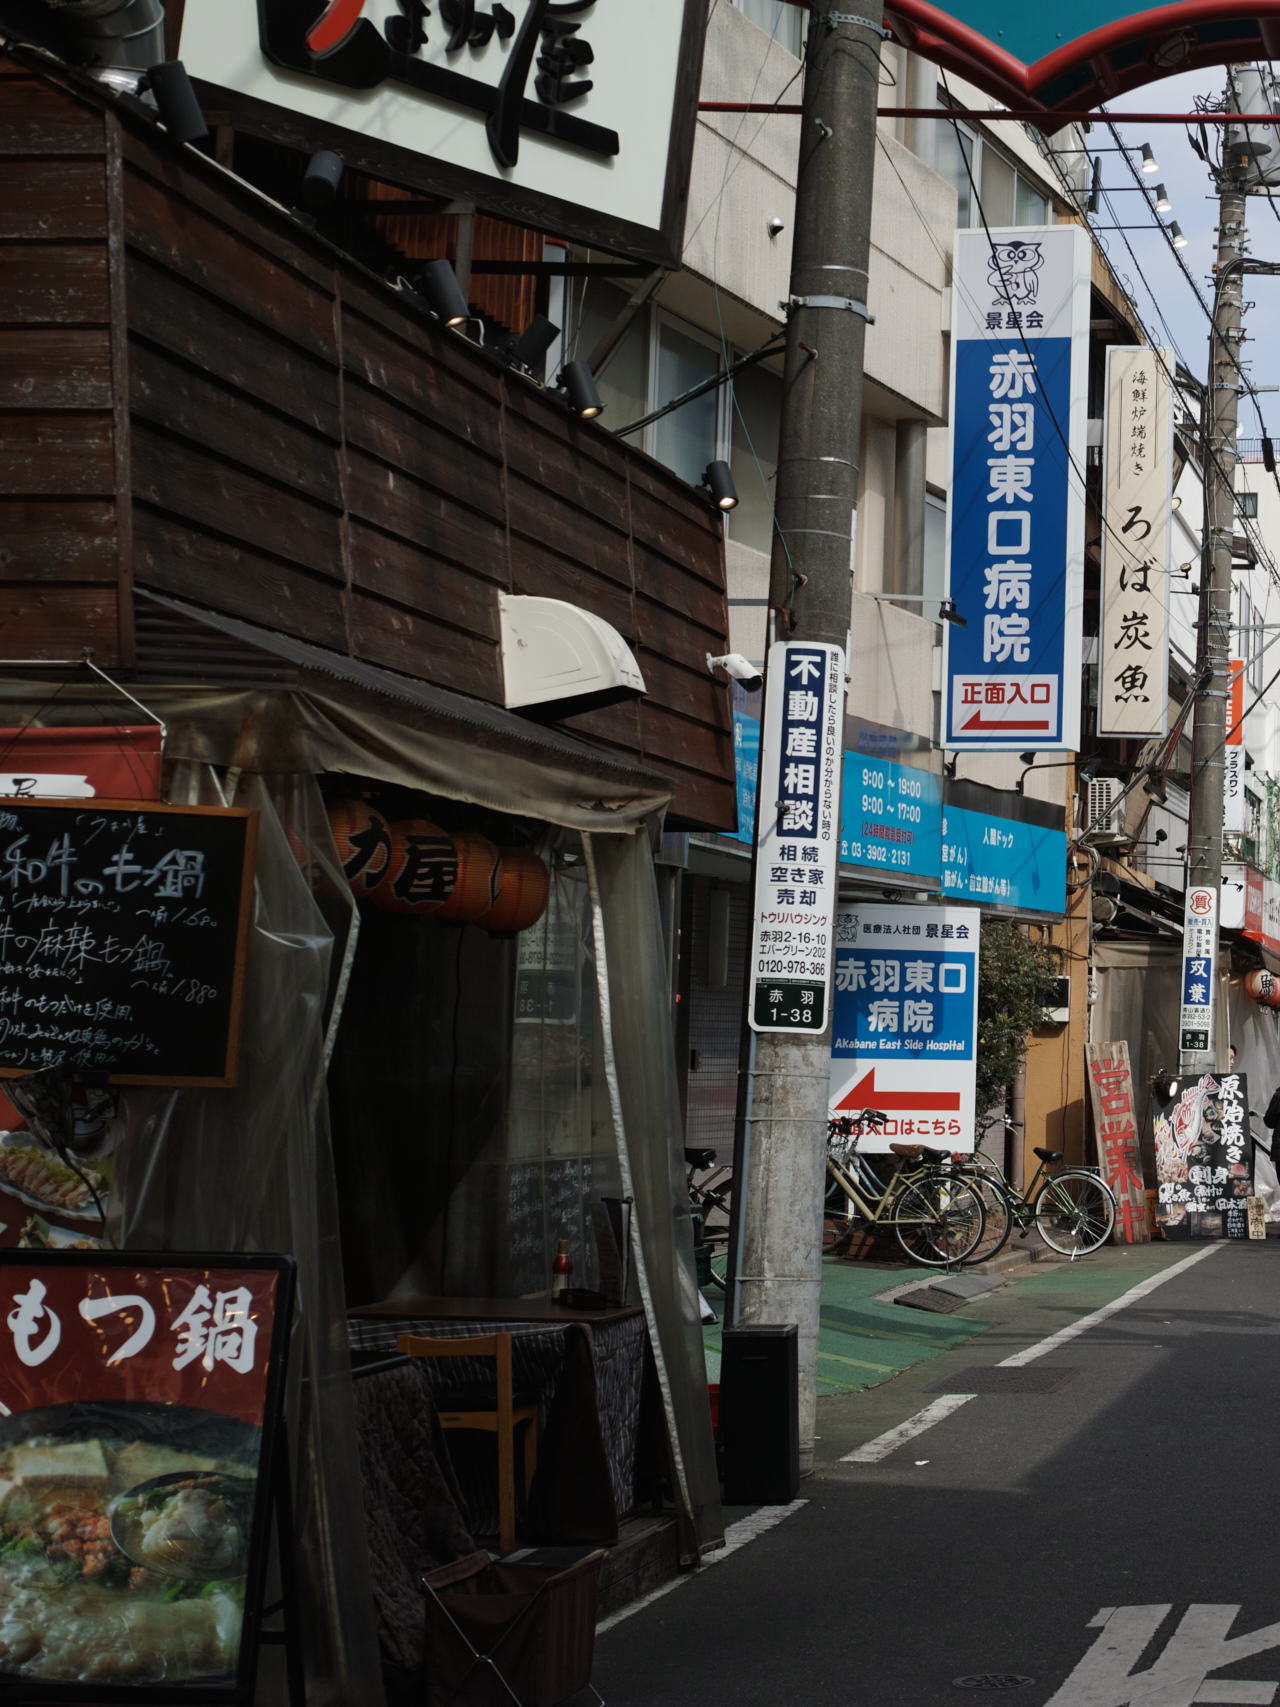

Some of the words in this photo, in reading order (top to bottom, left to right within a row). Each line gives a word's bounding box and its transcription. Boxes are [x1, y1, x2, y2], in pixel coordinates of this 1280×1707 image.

[985, 310, 1044, 330] 景星会
[1131, 371, 1149, 476] 海鮮炉端焼き
[983, 349, 1038, 663] 赤羽東口病院
[1114, 505, 1157, 704] ろば炭魚
[961, 682, 1050, 704] 正面入口
[782, 653, 822, 832] 不動産相談
[821, 650, 840, 841] 誰に相談したら良いのか分からない時の
[862, 768, 884, 790] 9:00
[898, 777, 921, 798] 19:00
[862, 794, 884, 815] 9:00
[898, 802, 921, 823] 17:00
[983, 827, 1014, 849] 人間ドック
[779, 844, 819, 863] 相続
[770, 866, 824, 885] 空き家
[777, 889, 816, 906] 売却
[1194, 895, 1208, 910] 質
[761, 912, 828, 926] トウリハウジング
[760, 931, 826, 946] 赤羽2-16-10
[863, 924, 921, 935] 医療法人社団
[925, 924, 970, 939] 景星会
[759, 944, 826, 958] エバーグリーン202
[758, 960, 825, 976] 0120-978-366
[835, 957, 967, 994] 赤羽東口
[1188, 960, 1208, 1003] 双葉
[769, 989, 814, 1005] 赤羽
[770, 1008, 812, 1023] 1-38
[867, 998, 934, 1033] 病院
[834, 1038, 878, 1049] Akabane
[879, 1038, 902, 1050] East
[904, 1039, 924, 1050] Side
[926, 1040, 965, 1052] Hospital
[1217, 1074, 1245, 1164] 原始焼き
[1091, 1059, 1144, 1243] 営業中
[1191, 1166, 1229, 1185] 刺身
[7, 1278, 258, 1374] もつ鍋
